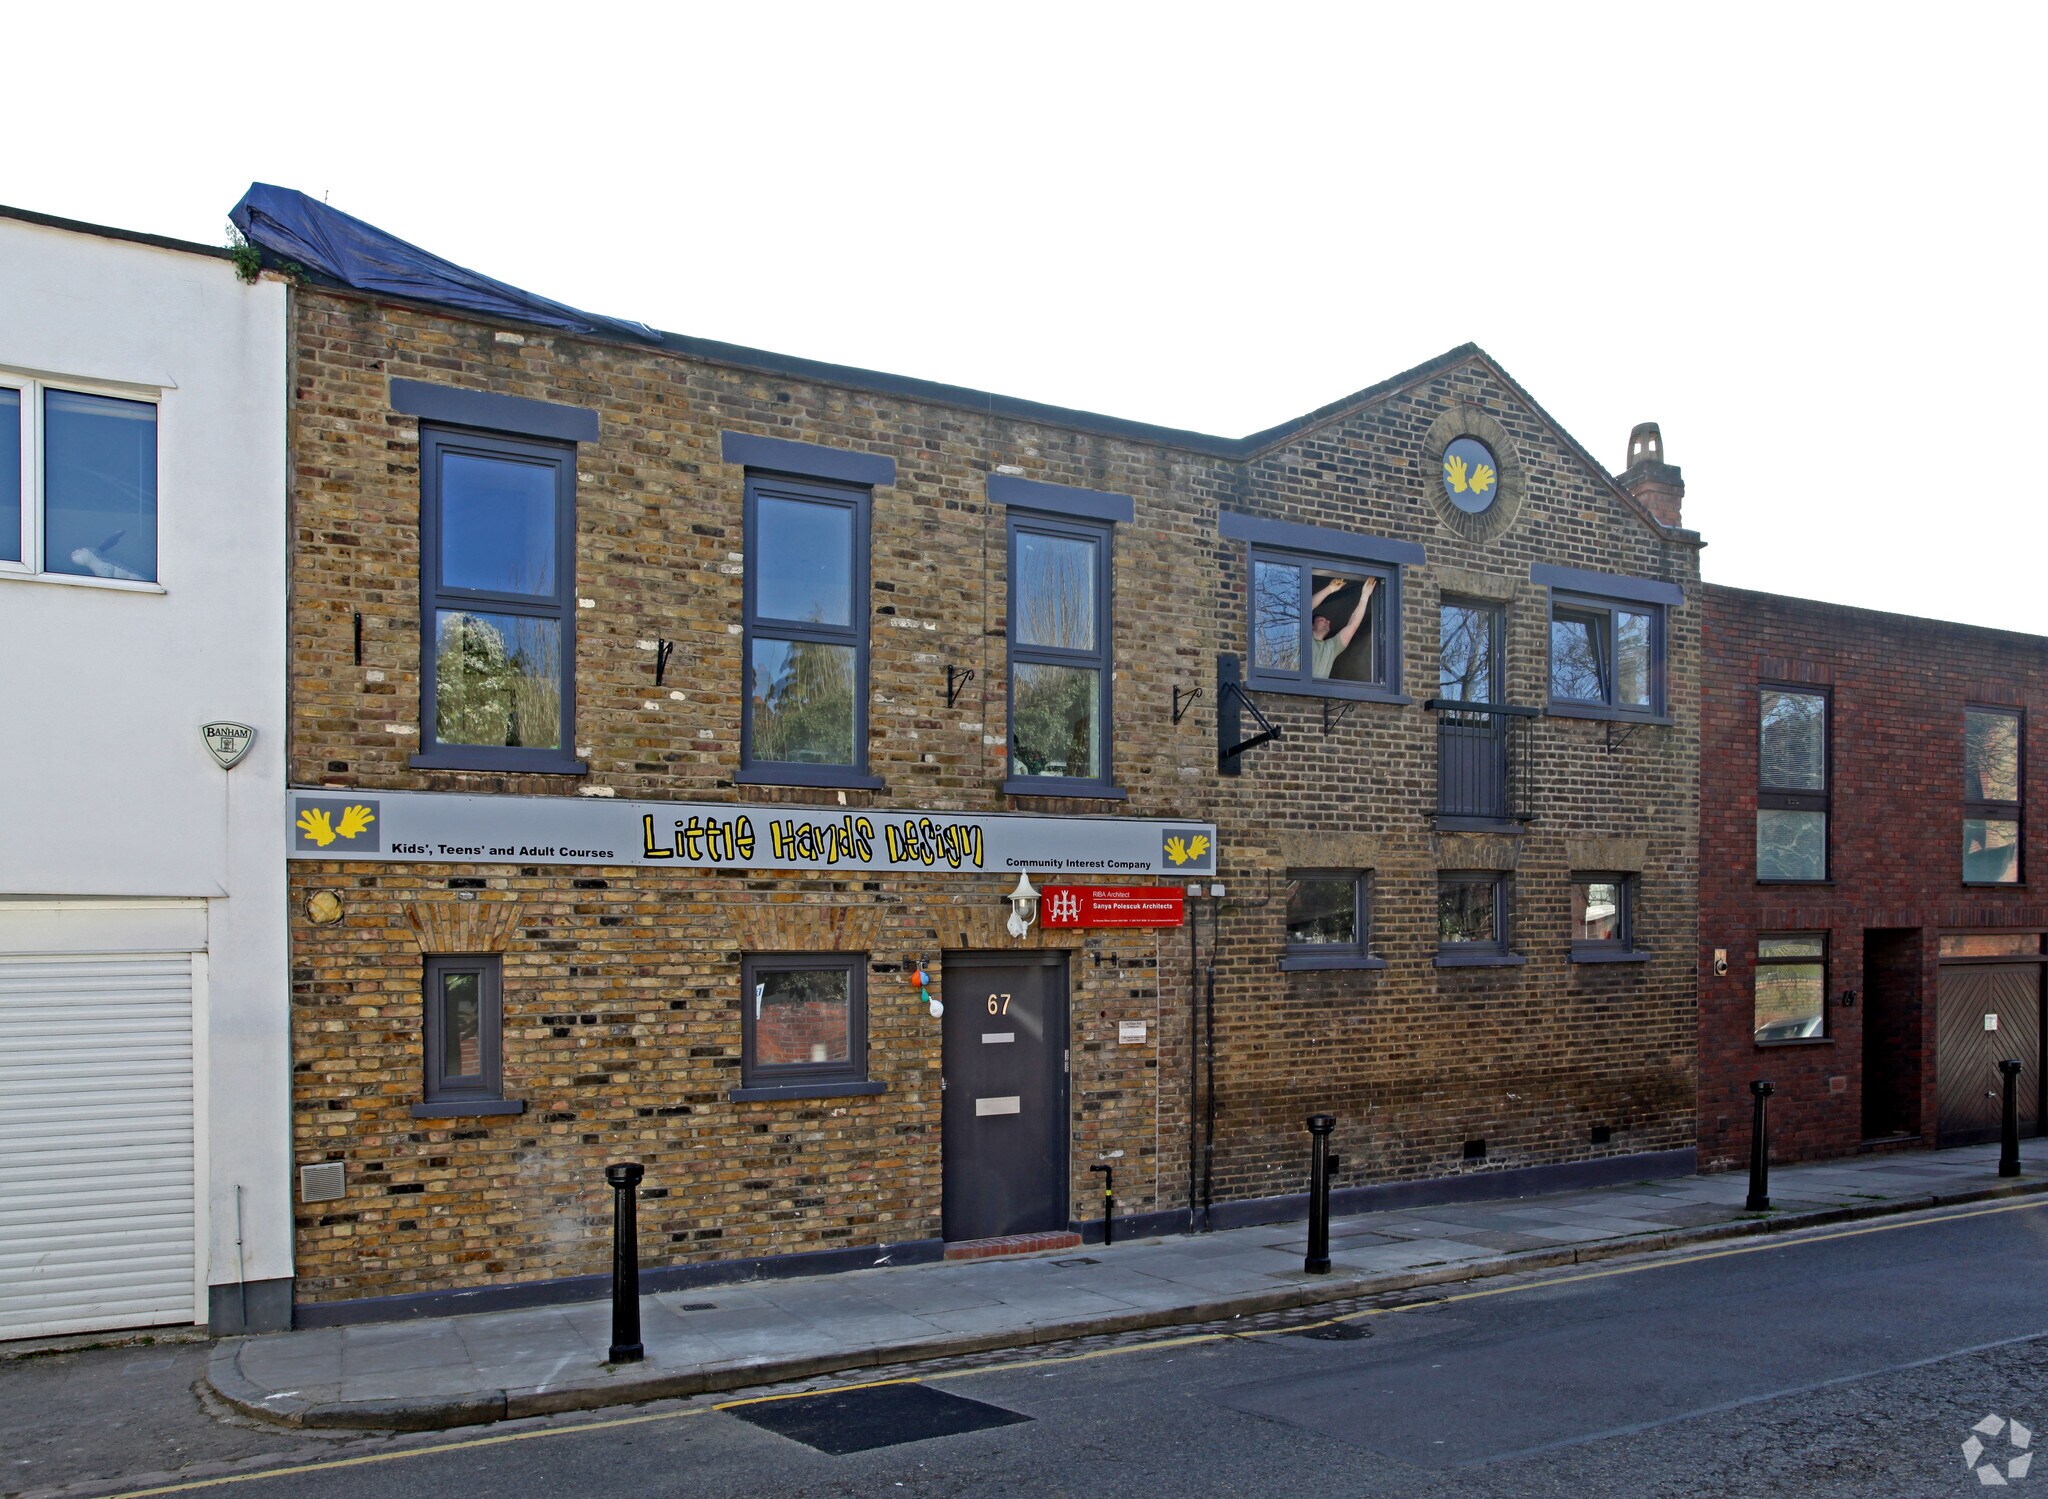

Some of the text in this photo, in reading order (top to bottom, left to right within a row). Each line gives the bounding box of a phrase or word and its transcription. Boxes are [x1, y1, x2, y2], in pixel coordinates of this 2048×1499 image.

[207, 727, 248, 738] BANHAM
[643, 814, 984, 869] Little Hands Design
[391, 843, 614, 858] Kids', Teens' and Adult Courses
[1006, 858, 1151, 870] Community Interest Company
[1093, 902, 1112, 910] Sanya
[987, 993, 1011, 1015] 67
